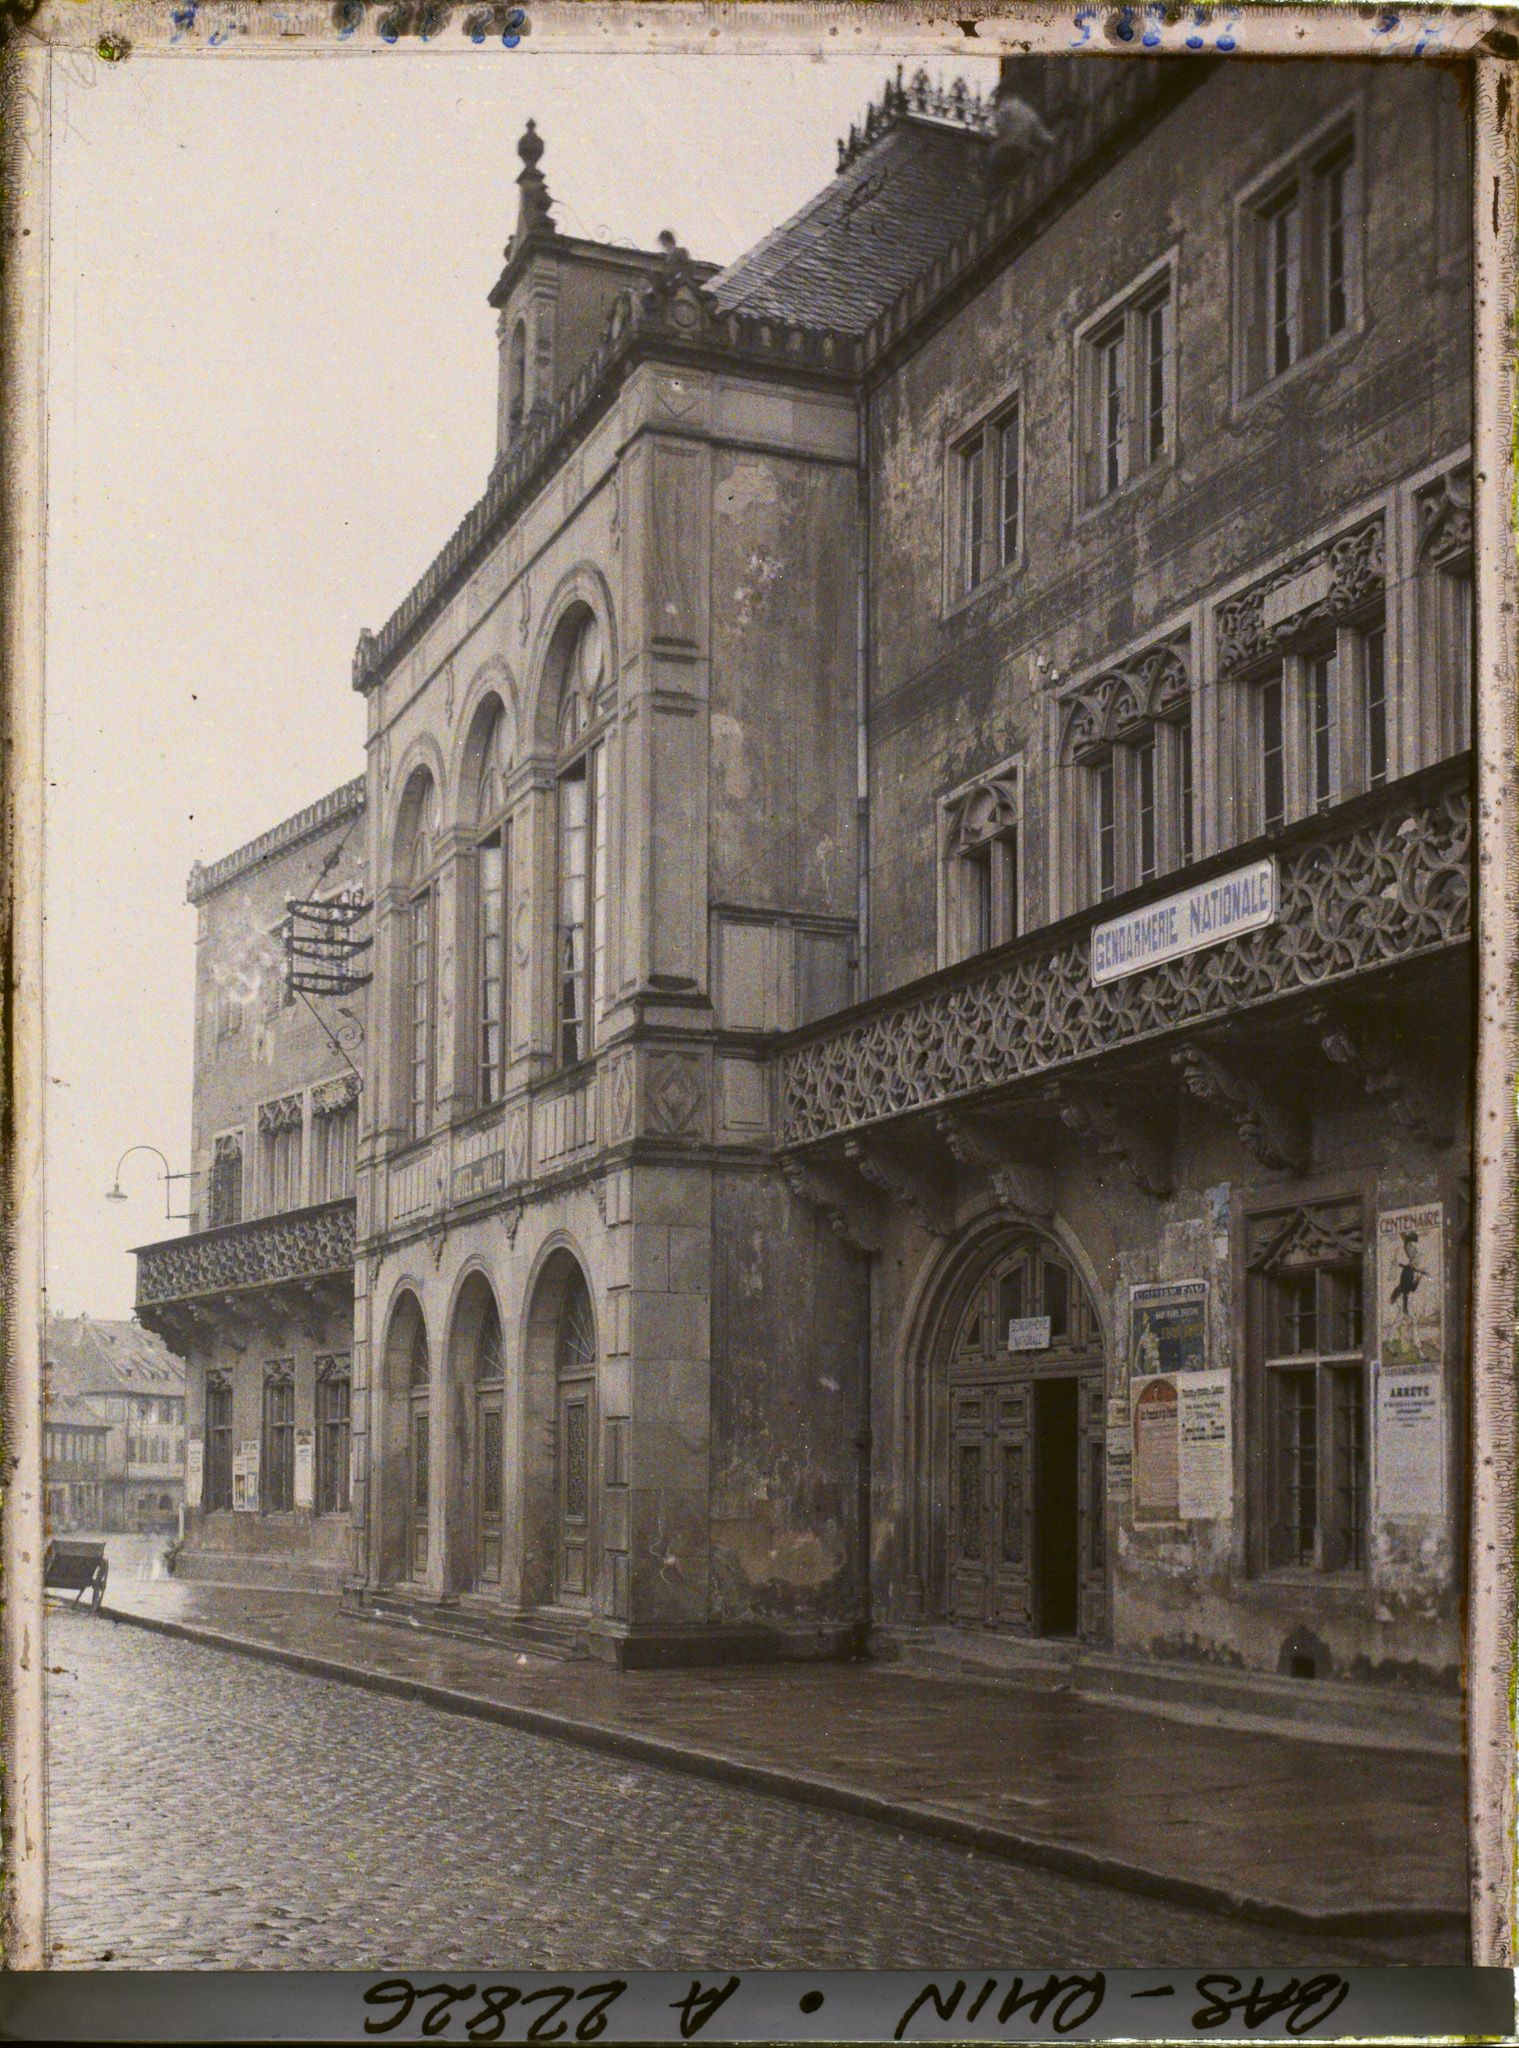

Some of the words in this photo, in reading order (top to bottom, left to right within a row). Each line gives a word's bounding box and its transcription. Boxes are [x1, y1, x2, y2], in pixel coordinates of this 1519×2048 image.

[1096, 906, 1178, 972] GENDARMERIE
[1190, 872, 1269, 937] NATIONALE
[1380, 1209, 1440, 1234] CENTENAIRE
[363, 1978, 629, 2042] 22826
